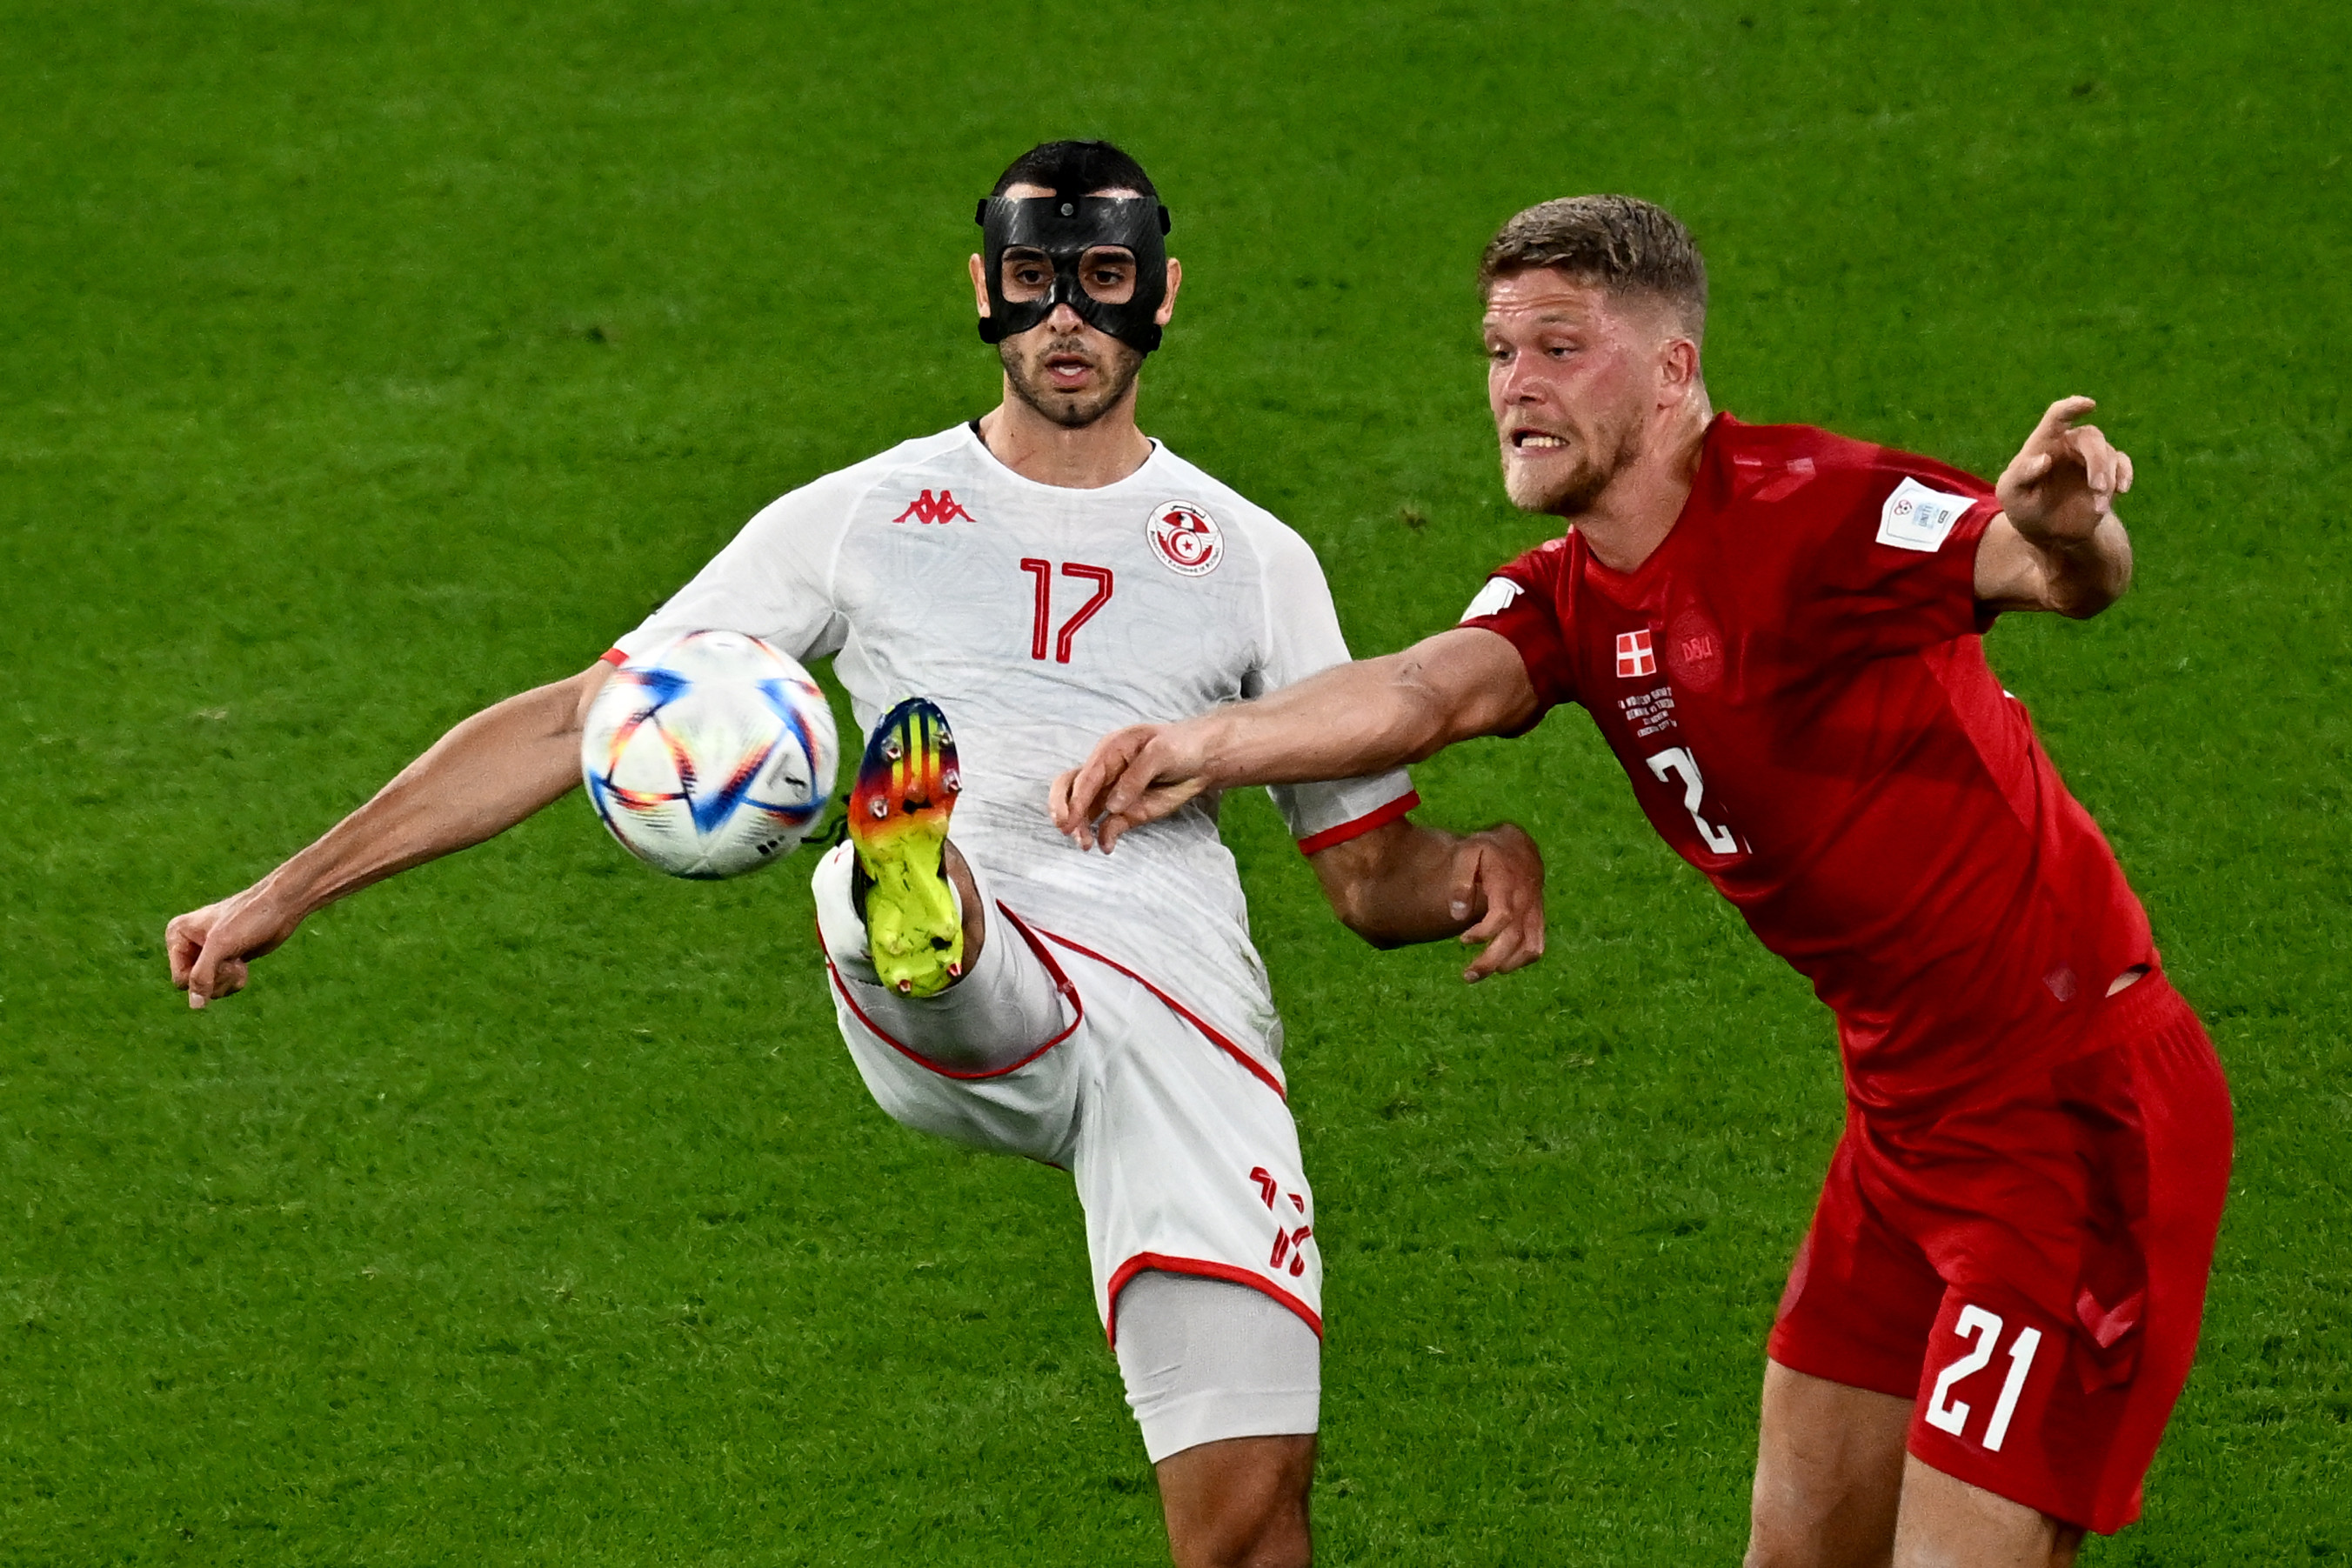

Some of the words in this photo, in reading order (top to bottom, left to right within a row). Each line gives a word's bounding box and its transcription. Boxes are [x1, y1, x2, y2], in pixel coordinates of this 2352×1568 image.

[1020, 557, 1113, 664] 17
[1681, 636, 1713, 662] DBU
[1646, 746, 1753, 854] 2
[1925, 1304, 2042, 1452] 21
